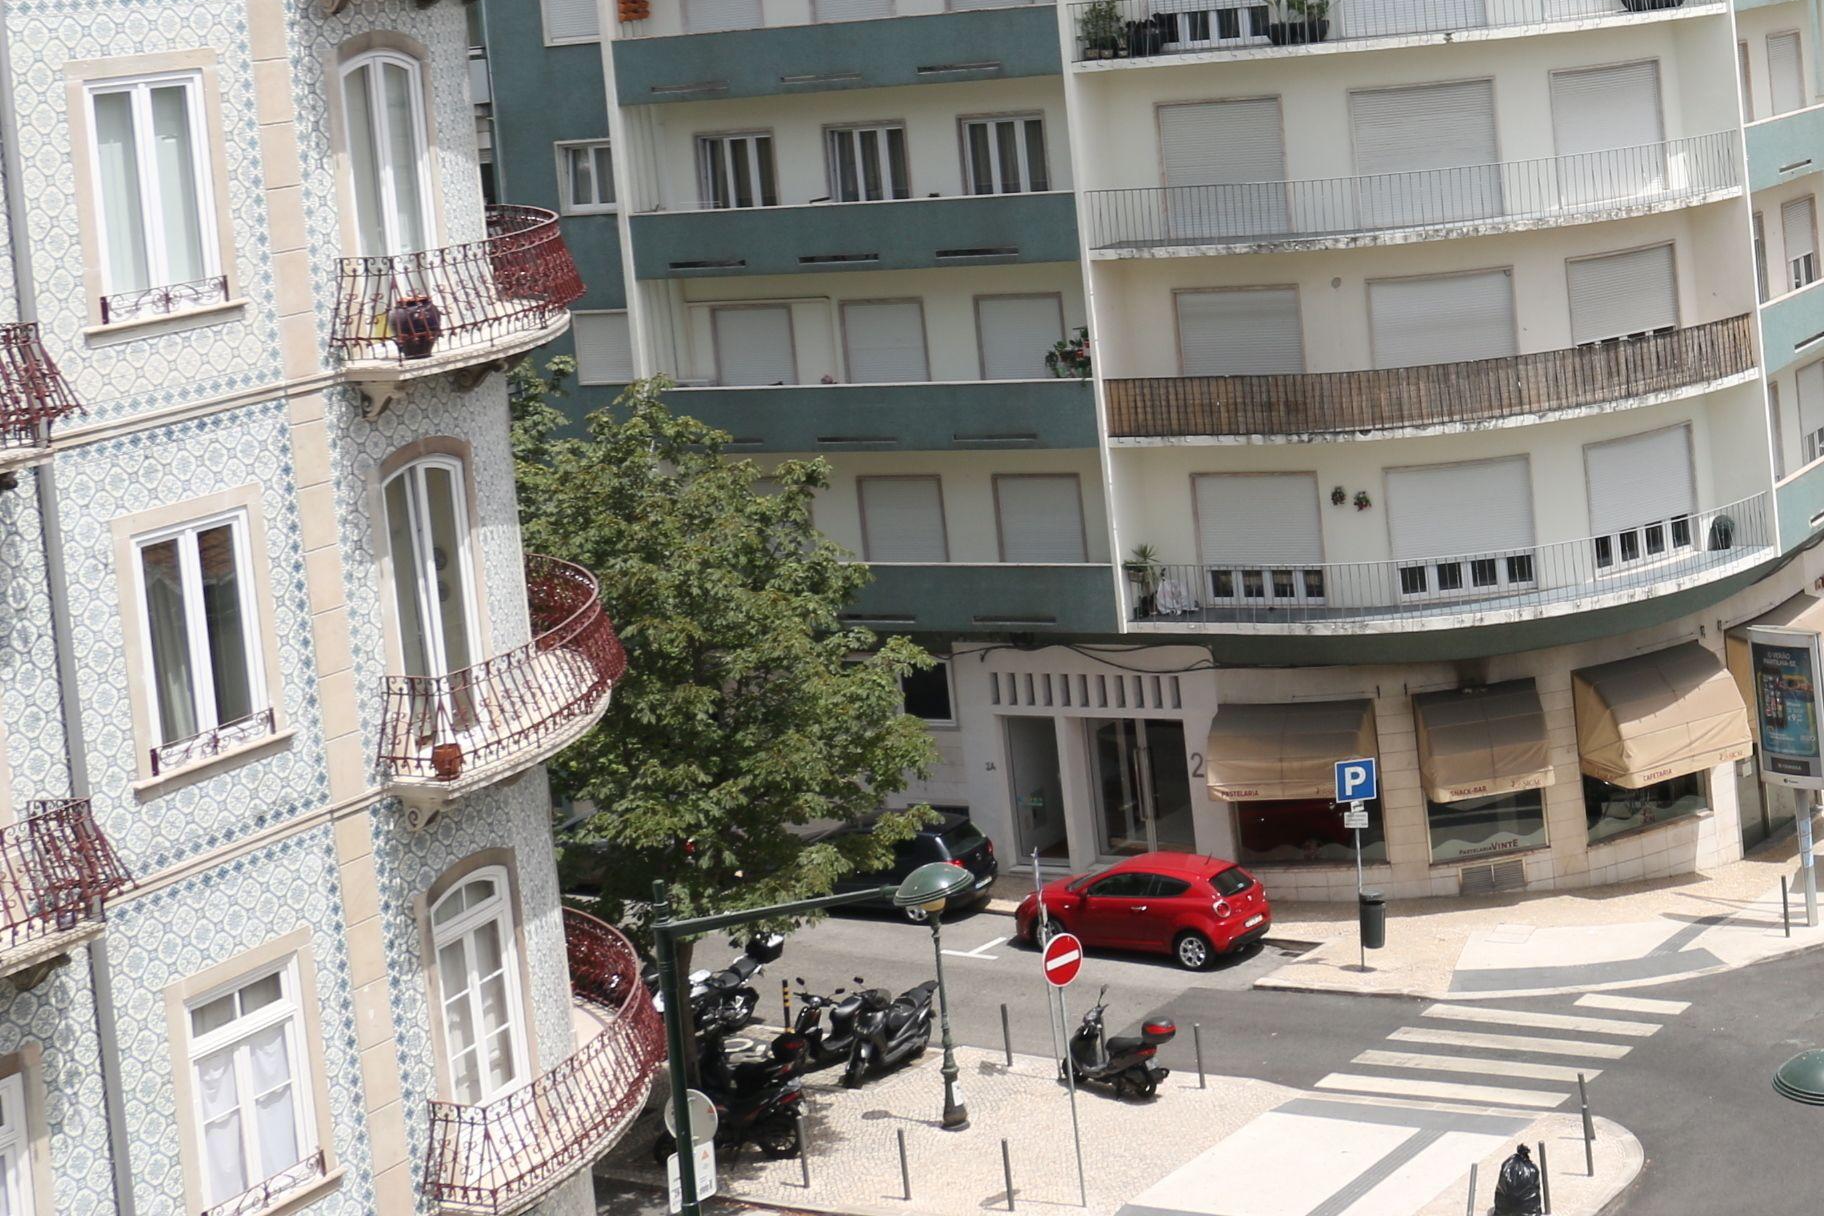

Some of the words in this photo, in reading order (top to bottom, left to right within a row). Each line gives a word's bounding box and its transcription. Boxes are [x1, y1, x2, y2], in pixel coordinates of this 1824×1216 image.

[1190, 752, 1205, 778] 2
[1344, 765, 1366, 796] P
[1643, 768, 1673, 782] CAFETARIA
[1221, 790, 1259, 798] PASTELARIA
[1450, 785, 1488, 797] SNACK-BAR
